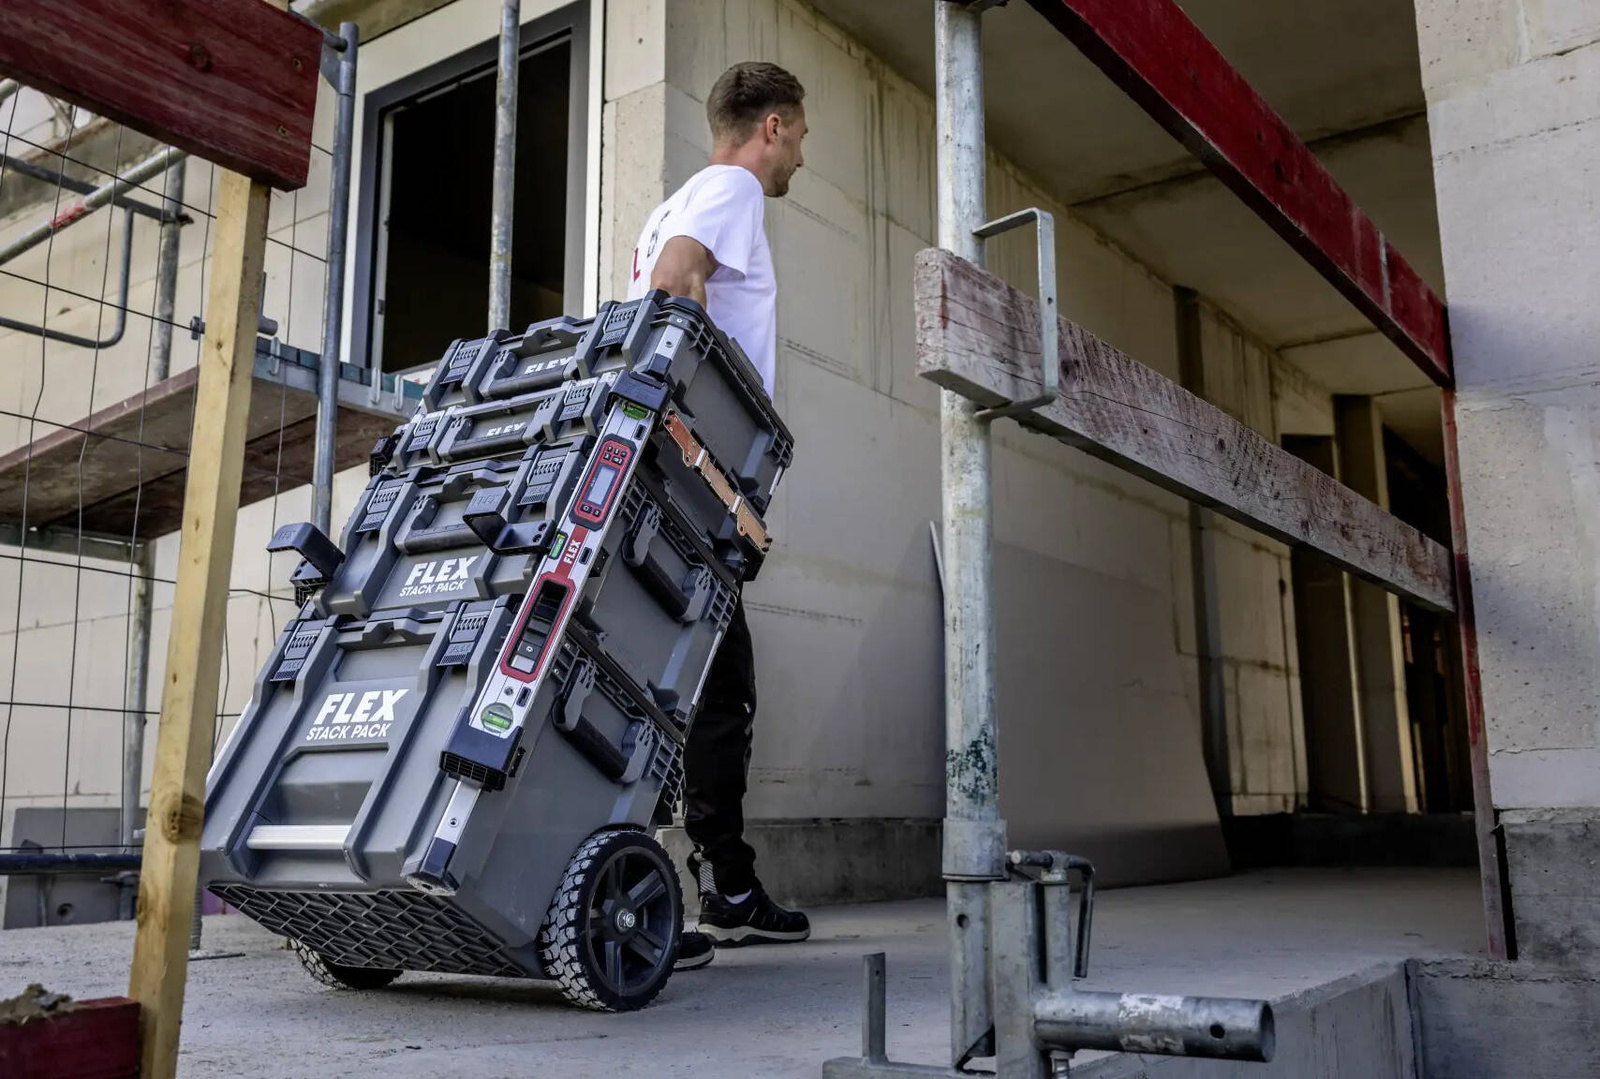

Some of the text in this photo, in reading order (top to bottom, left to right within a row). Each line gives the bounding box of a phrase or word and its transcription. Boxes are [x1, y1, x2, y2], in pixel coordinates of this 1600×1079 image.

[563, 539, 581, 564] FLEX
[405, 555, 479, 586] FLEX
[400, 580, 467, 597] STACK PACK
[313, 688, 410, 725] FLEX
[306, 723, 392, 741] STACK PACK
